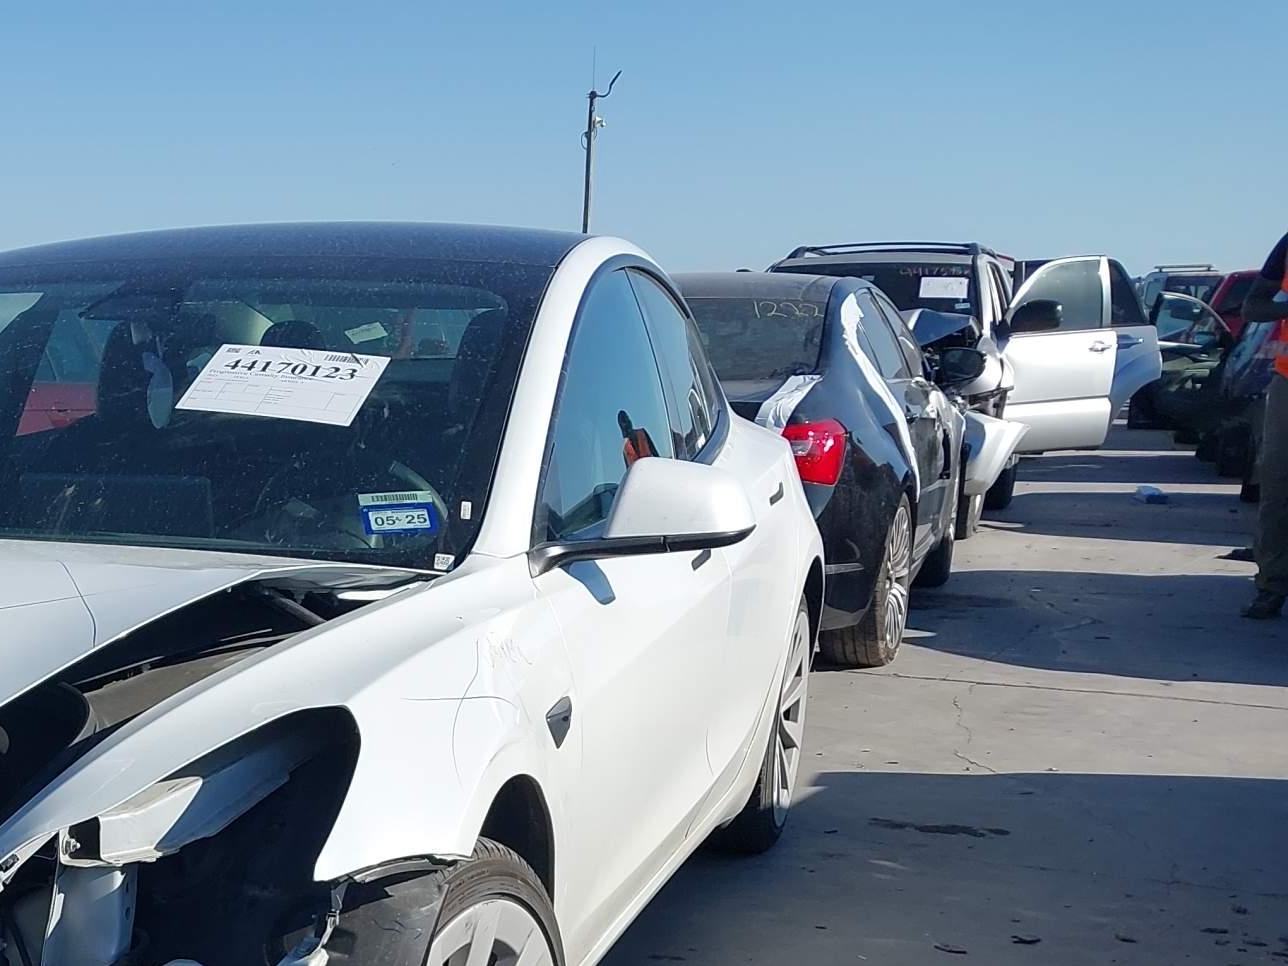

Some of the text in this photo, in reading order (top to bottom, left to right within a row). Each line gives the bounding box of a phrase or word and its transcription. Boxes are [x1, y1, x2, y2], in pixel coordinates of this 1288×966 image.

[224, 357, 358, 381] 44170123
[374, 513, 428, 527] 05 25
